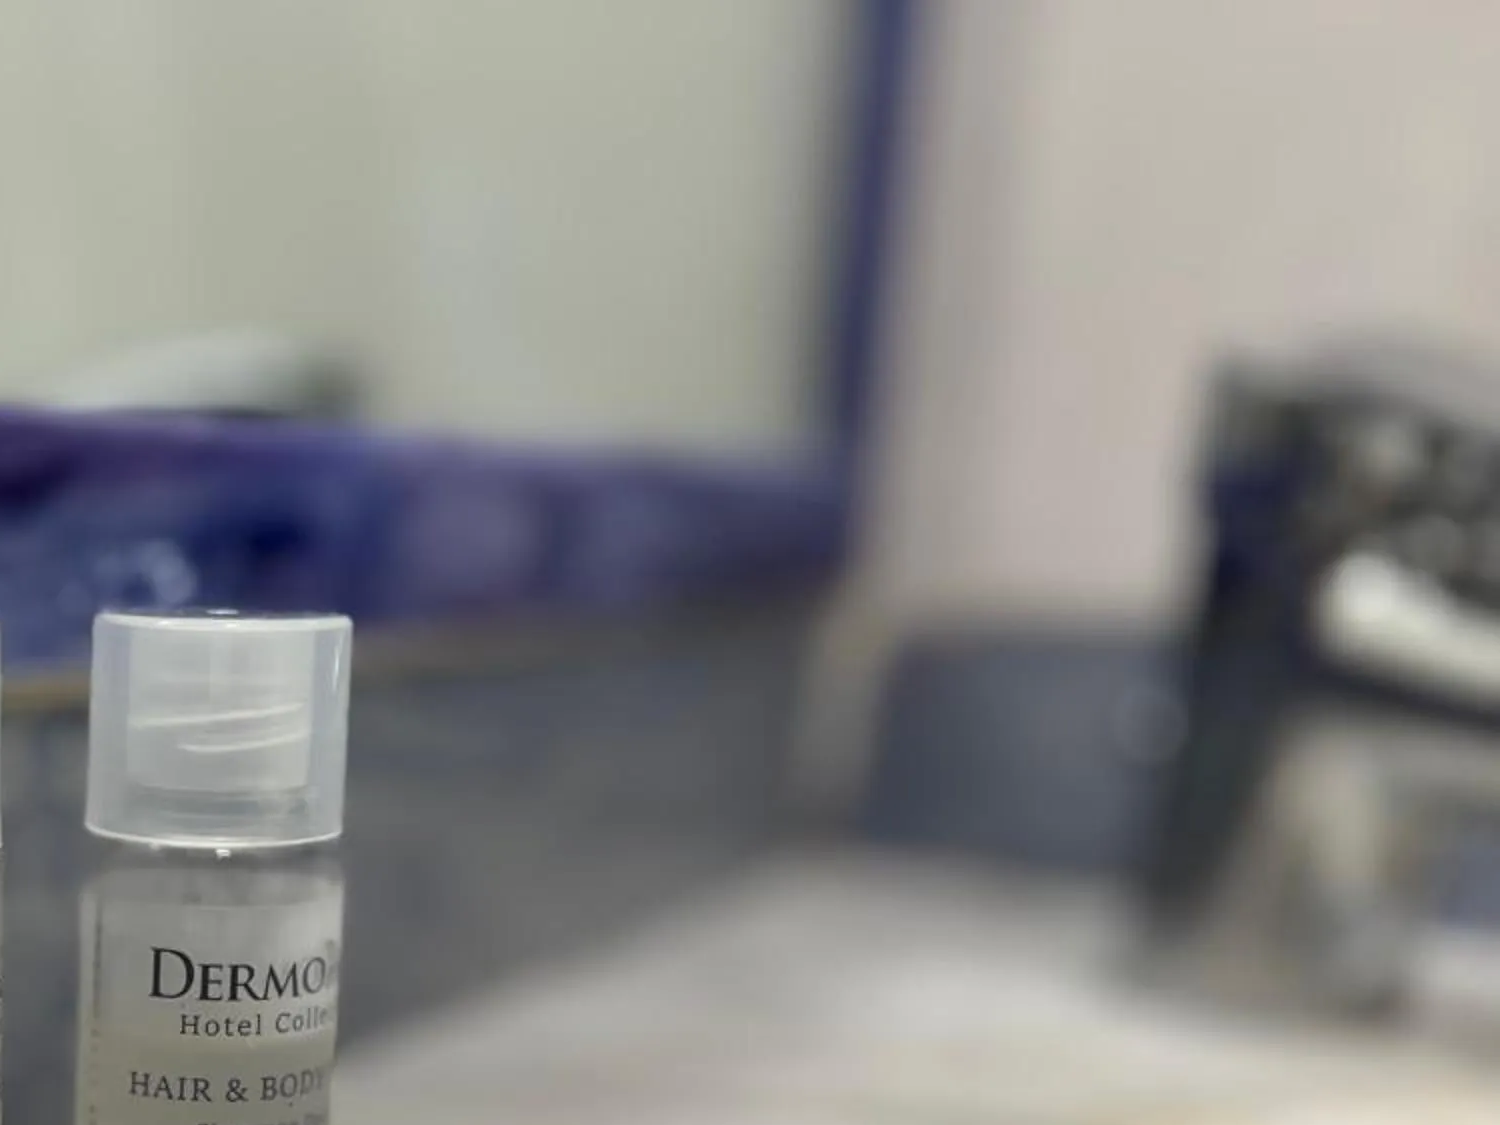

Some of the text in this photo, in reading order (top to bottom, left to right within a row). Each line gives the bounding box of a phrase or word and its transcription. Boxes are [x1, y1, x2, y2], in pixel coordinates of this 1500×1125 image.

[179, 1013, 262, 1037] Hotel
[128, 1070, 212, 1102] HAIR
[225, 1078, 249, 1102] &
